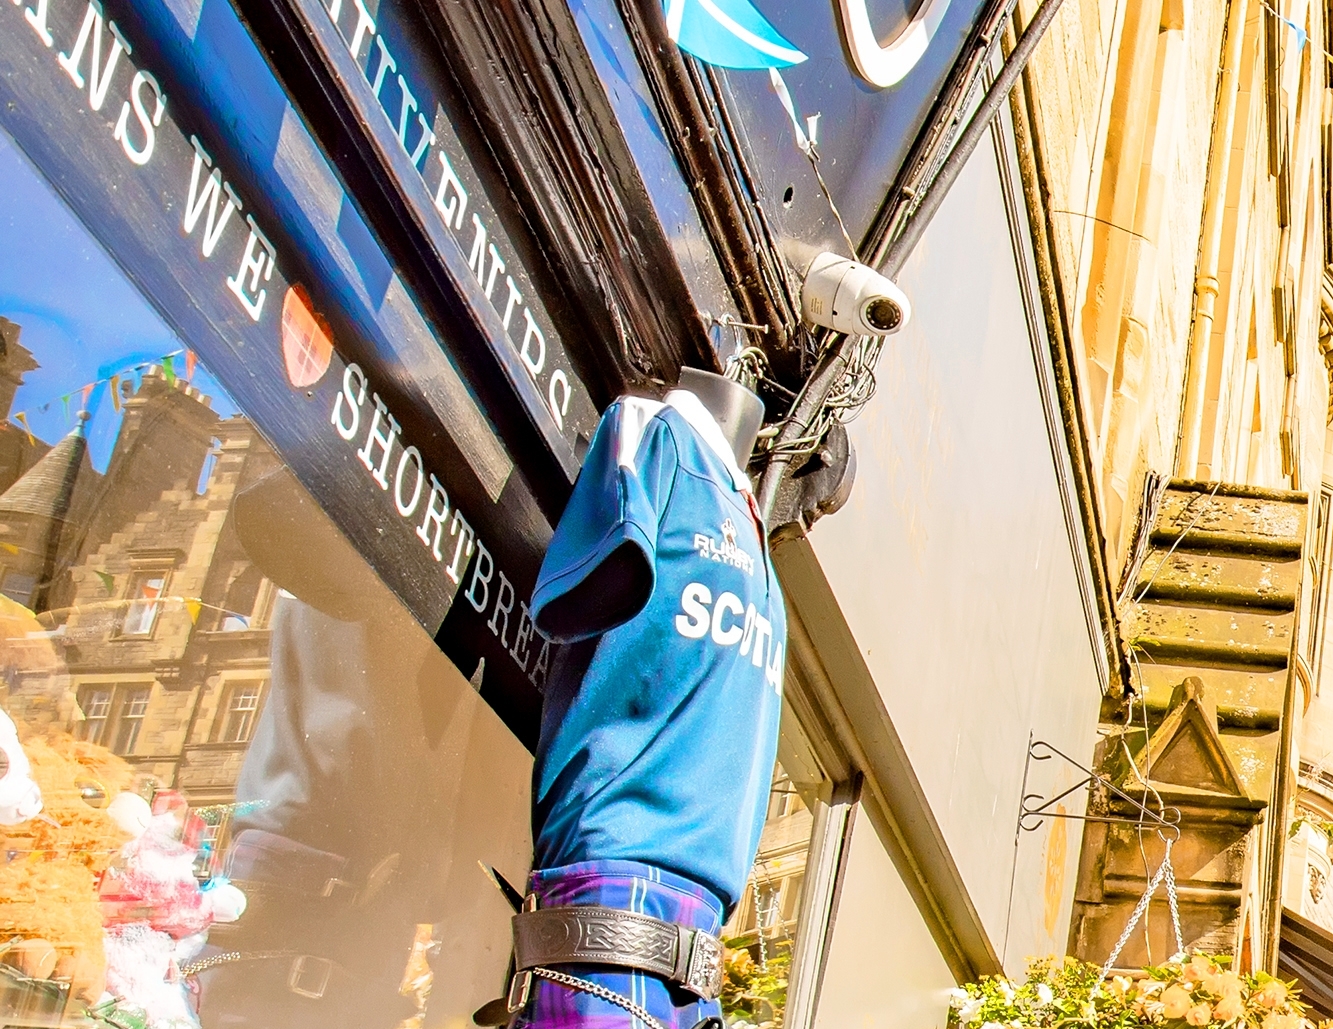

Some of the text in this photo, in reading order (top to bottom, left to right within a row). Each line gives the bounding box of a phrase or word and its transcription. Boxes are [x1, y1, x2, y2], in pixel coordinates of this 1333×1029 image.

[182, 135, 277, 322] WE
[694, 533, 755, 570] RUGBY
[700, 549, 754, 577] NATIONS
